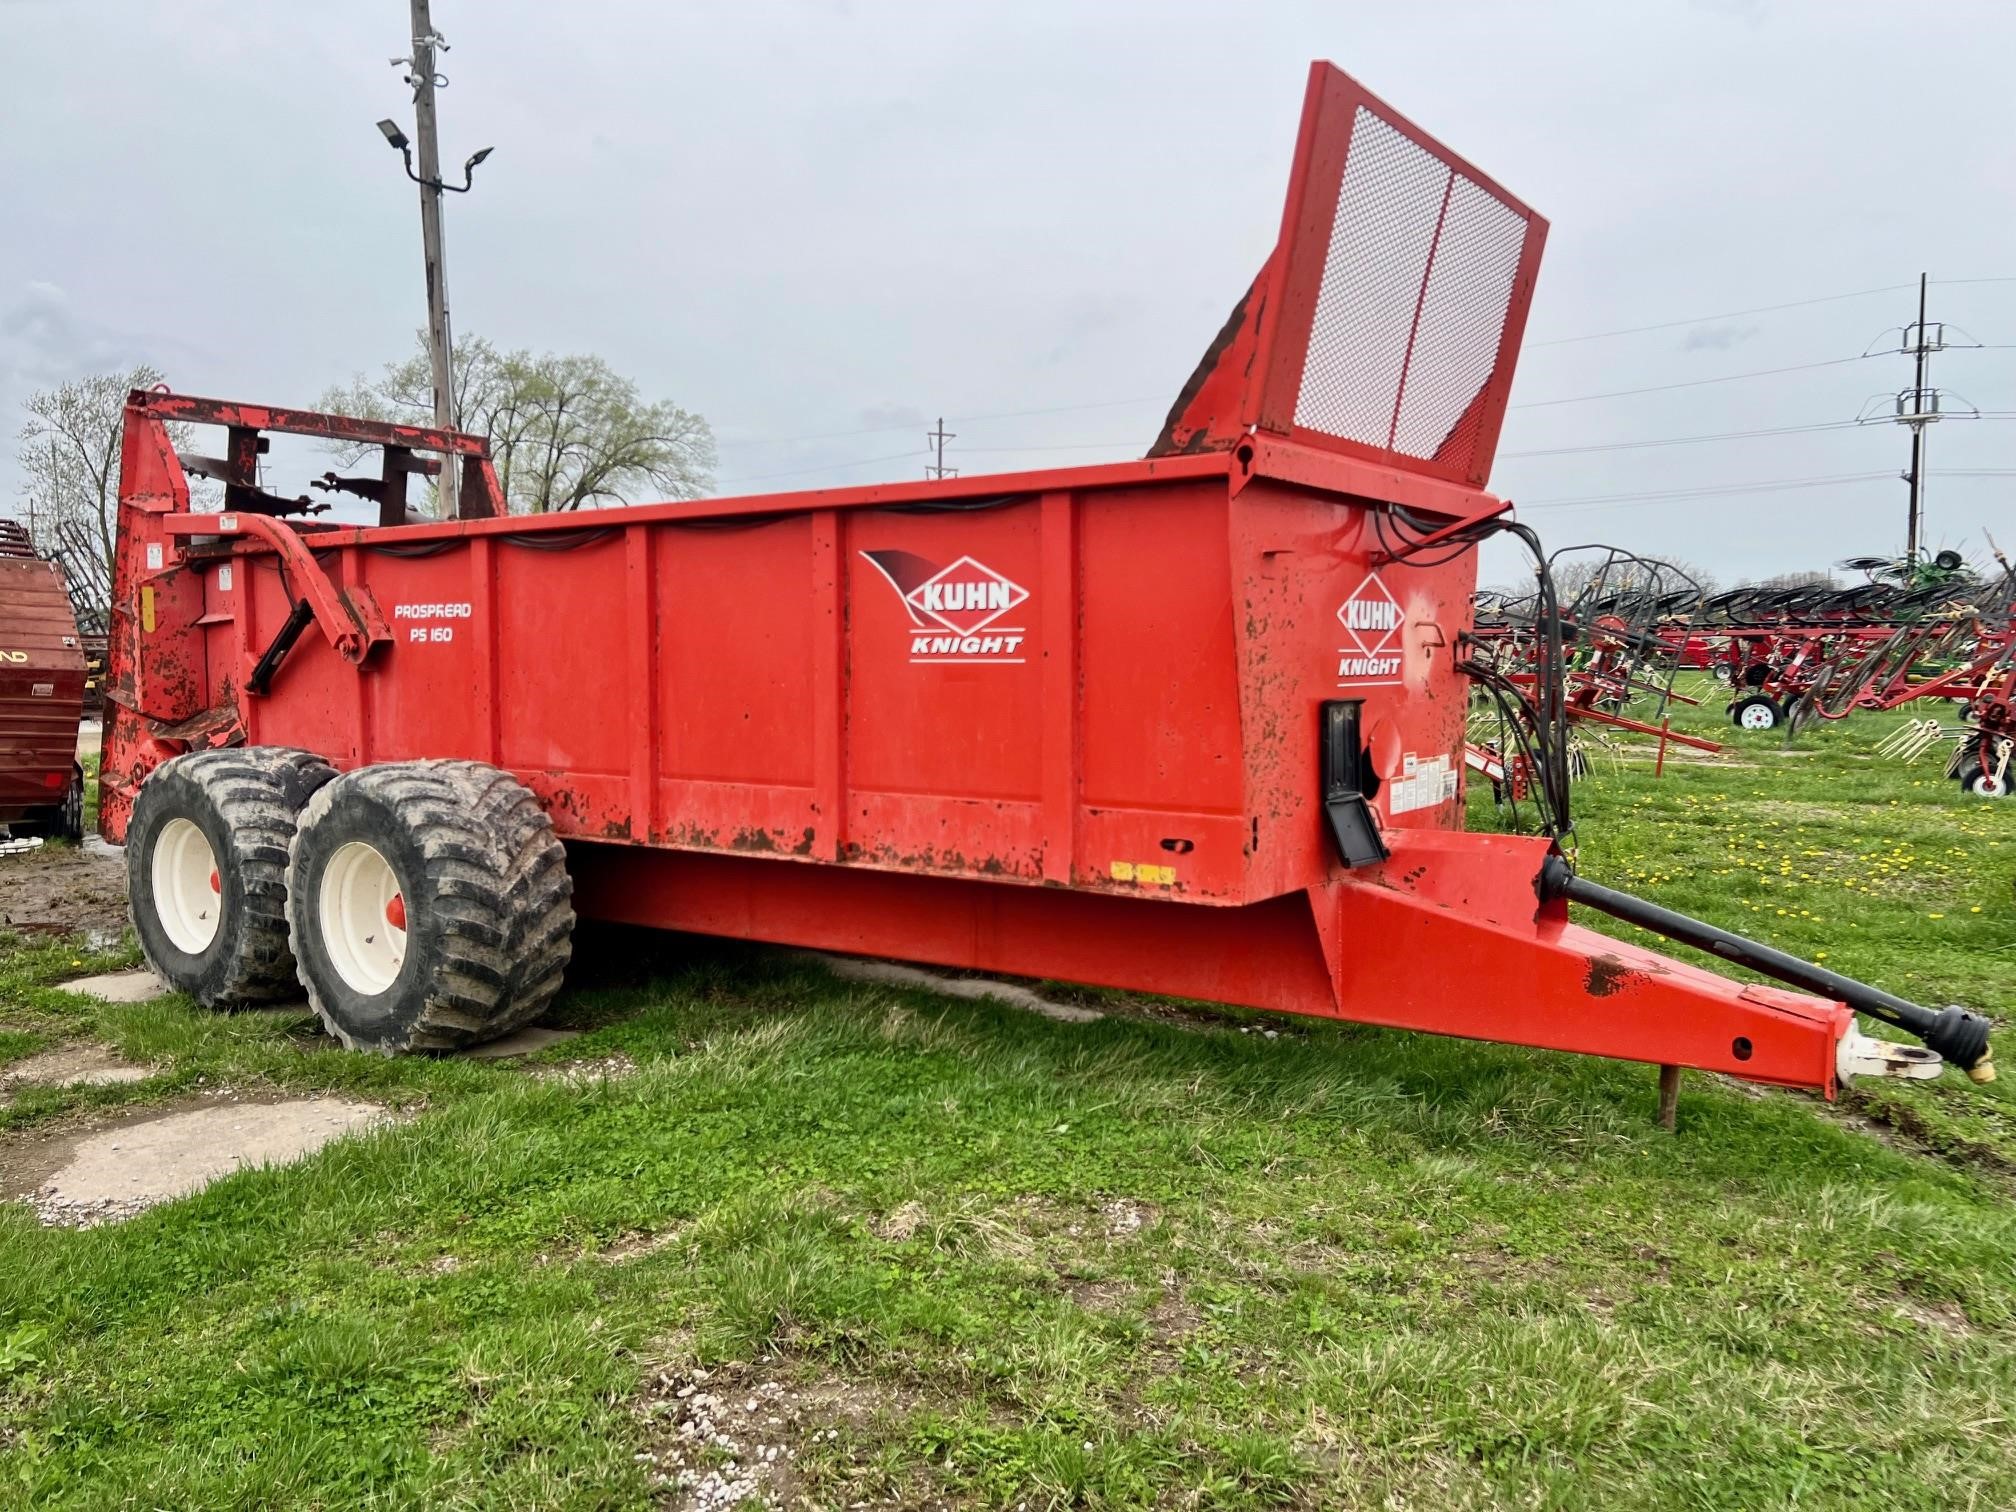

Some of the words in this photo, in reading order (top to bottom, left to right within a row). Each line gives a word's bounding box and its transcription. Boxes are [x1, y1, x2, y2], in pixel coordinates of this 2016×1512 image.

[923, 581, 1011, 611] KUHN
[394, 603, 472, 619] PROSPREAD
[1347, 600, 1396, 630] KUHN
[410, 628, 427, 642] PS
[430, 627, 453, 642] 160
[911, 636, 1024, 654] KNIGHT
[1338, 658, 1402, 676] KNIGHT
